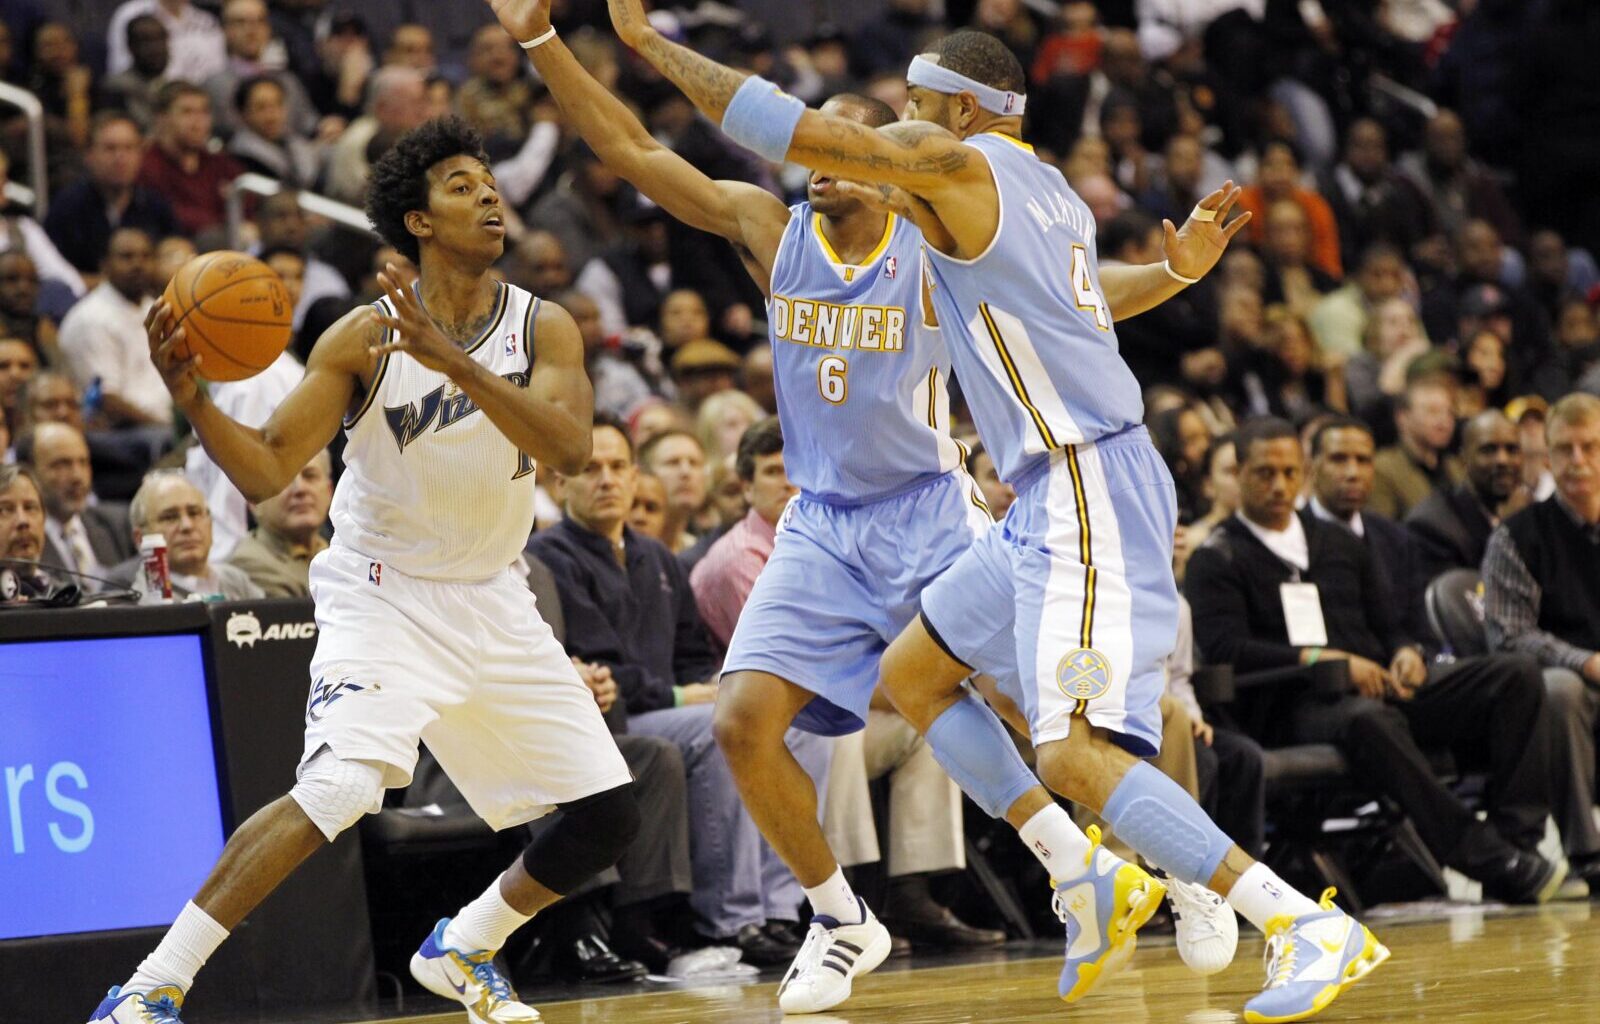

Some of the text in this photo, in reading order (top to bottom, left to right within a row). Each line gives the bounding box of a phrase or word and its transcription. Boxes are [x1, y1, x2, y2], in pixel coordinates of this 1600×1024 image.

[1070, 241, 1109, 332] 4
[774, 293, 906, 352] DENVER
[817, 354, 849, 406] 6
[263, 622, 317, 641] ANC
[5, 761, 95, 854] rs
